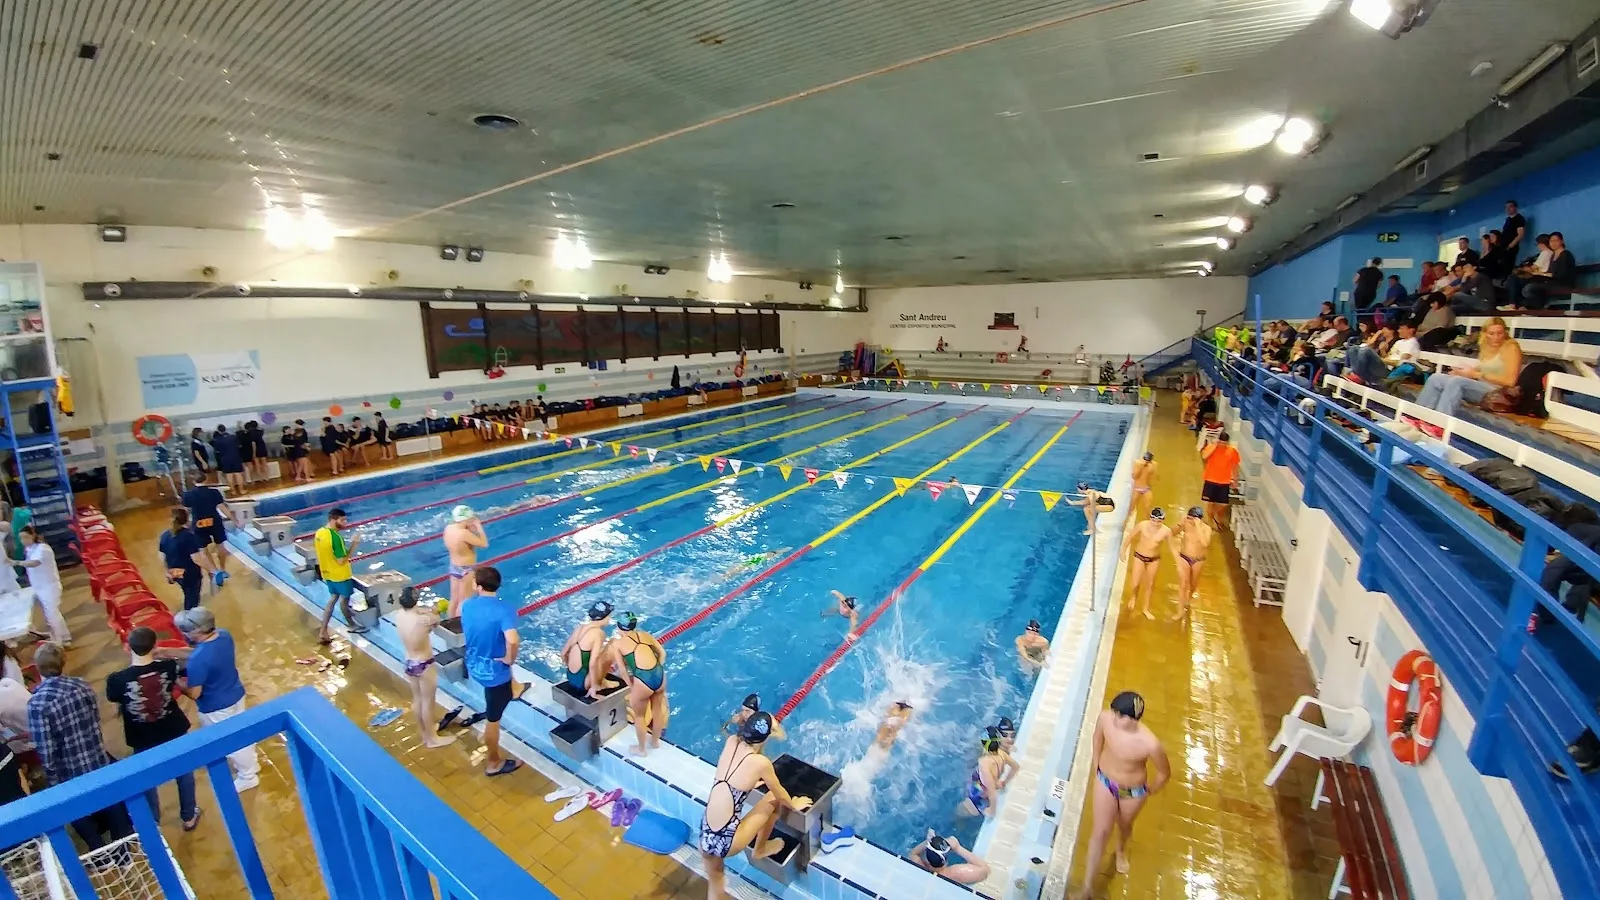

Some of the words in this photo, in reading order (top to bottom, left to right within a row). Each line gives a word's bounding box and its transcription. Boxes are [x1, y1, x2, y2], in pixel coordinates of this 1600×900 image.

[899, 313, 917, 321] Sant
[919, 313, 947, 321] Andreu
[201, 372, 255, 383] KUMON
[278, 531, 285, 541] 6
[386, 593, 395, 605] 4
[609, 708, 618, 727] 2
